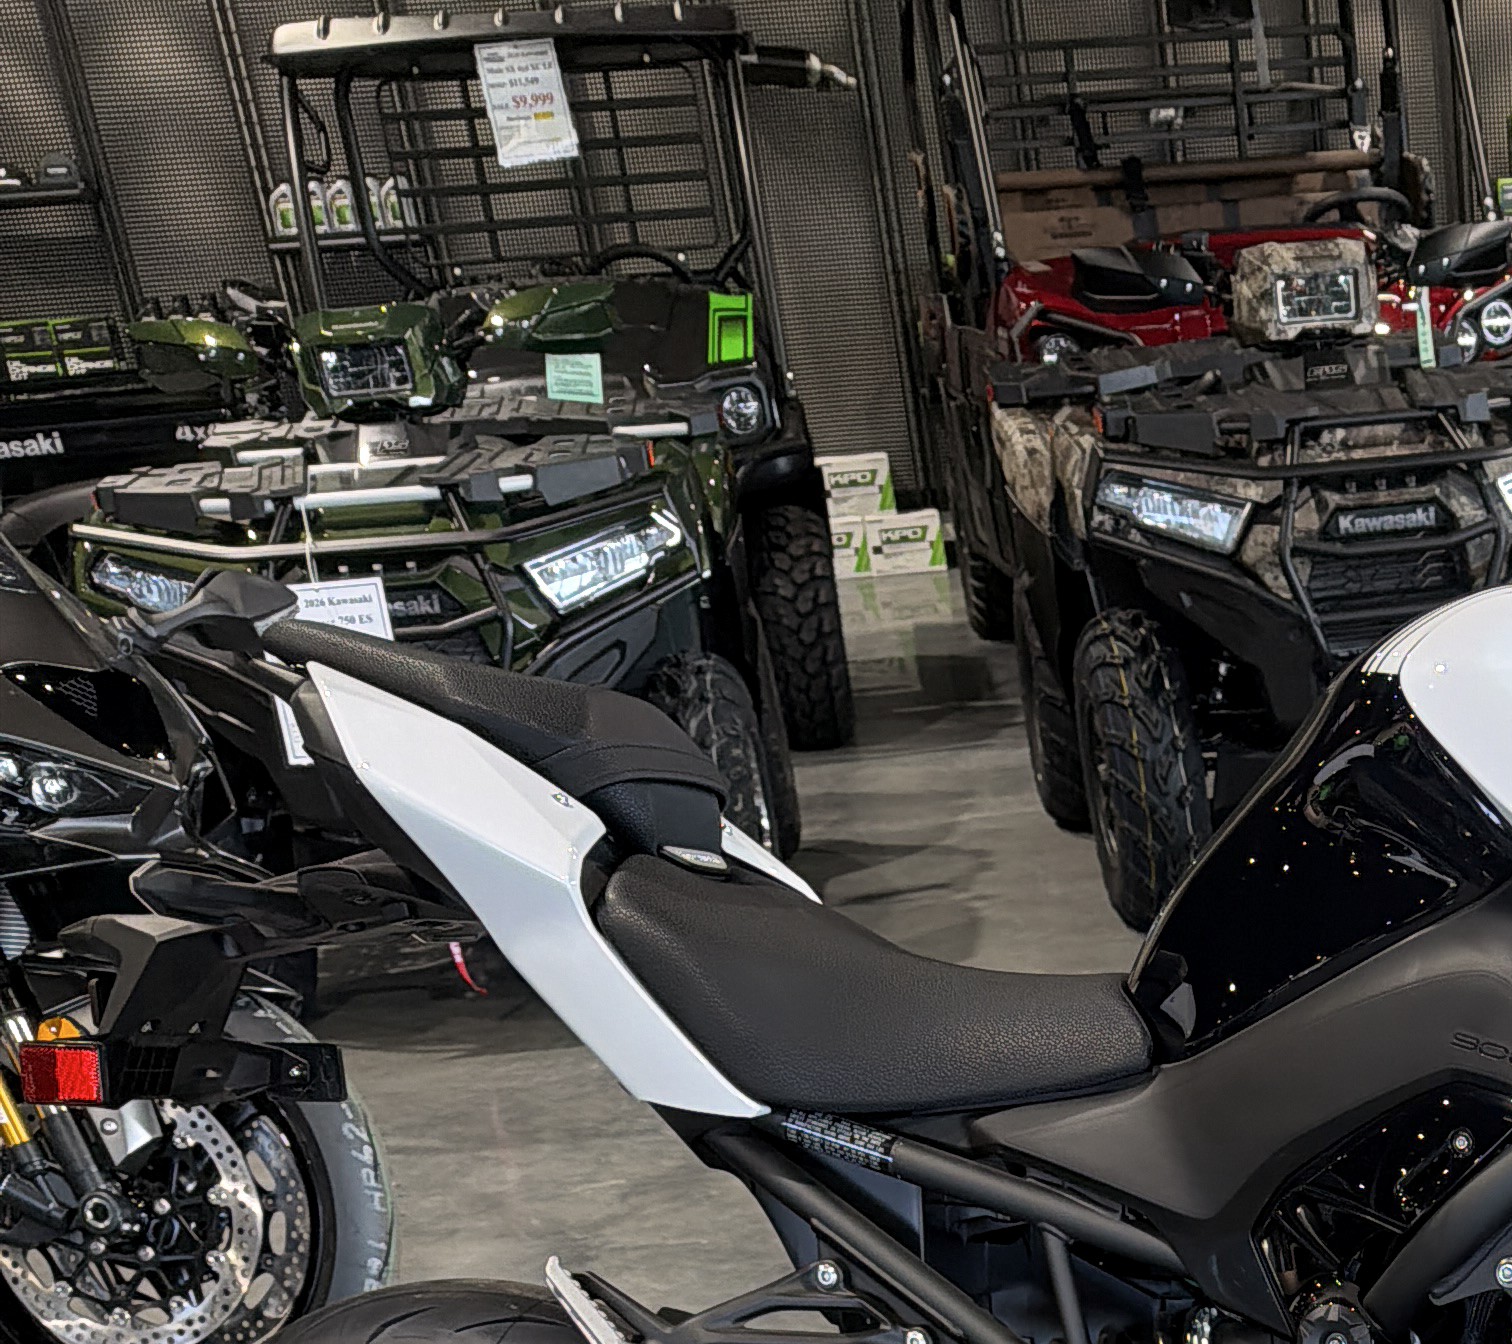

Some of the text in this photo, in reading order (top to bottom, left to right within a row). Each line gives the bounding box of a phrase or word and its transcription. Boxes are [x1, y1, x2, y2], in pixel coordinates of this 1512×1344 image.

[511, 92, 553, 111] $9,999
[175, 425, 208, 442] 4x
[0, 431, 64, 459] asaki
[1338, 506, 1436, 534] Kawasaki
[328, 593, 373, 608] Kawasaki
[388, 594, 441, 617] saki
[358, 614, 373, 624] ES
